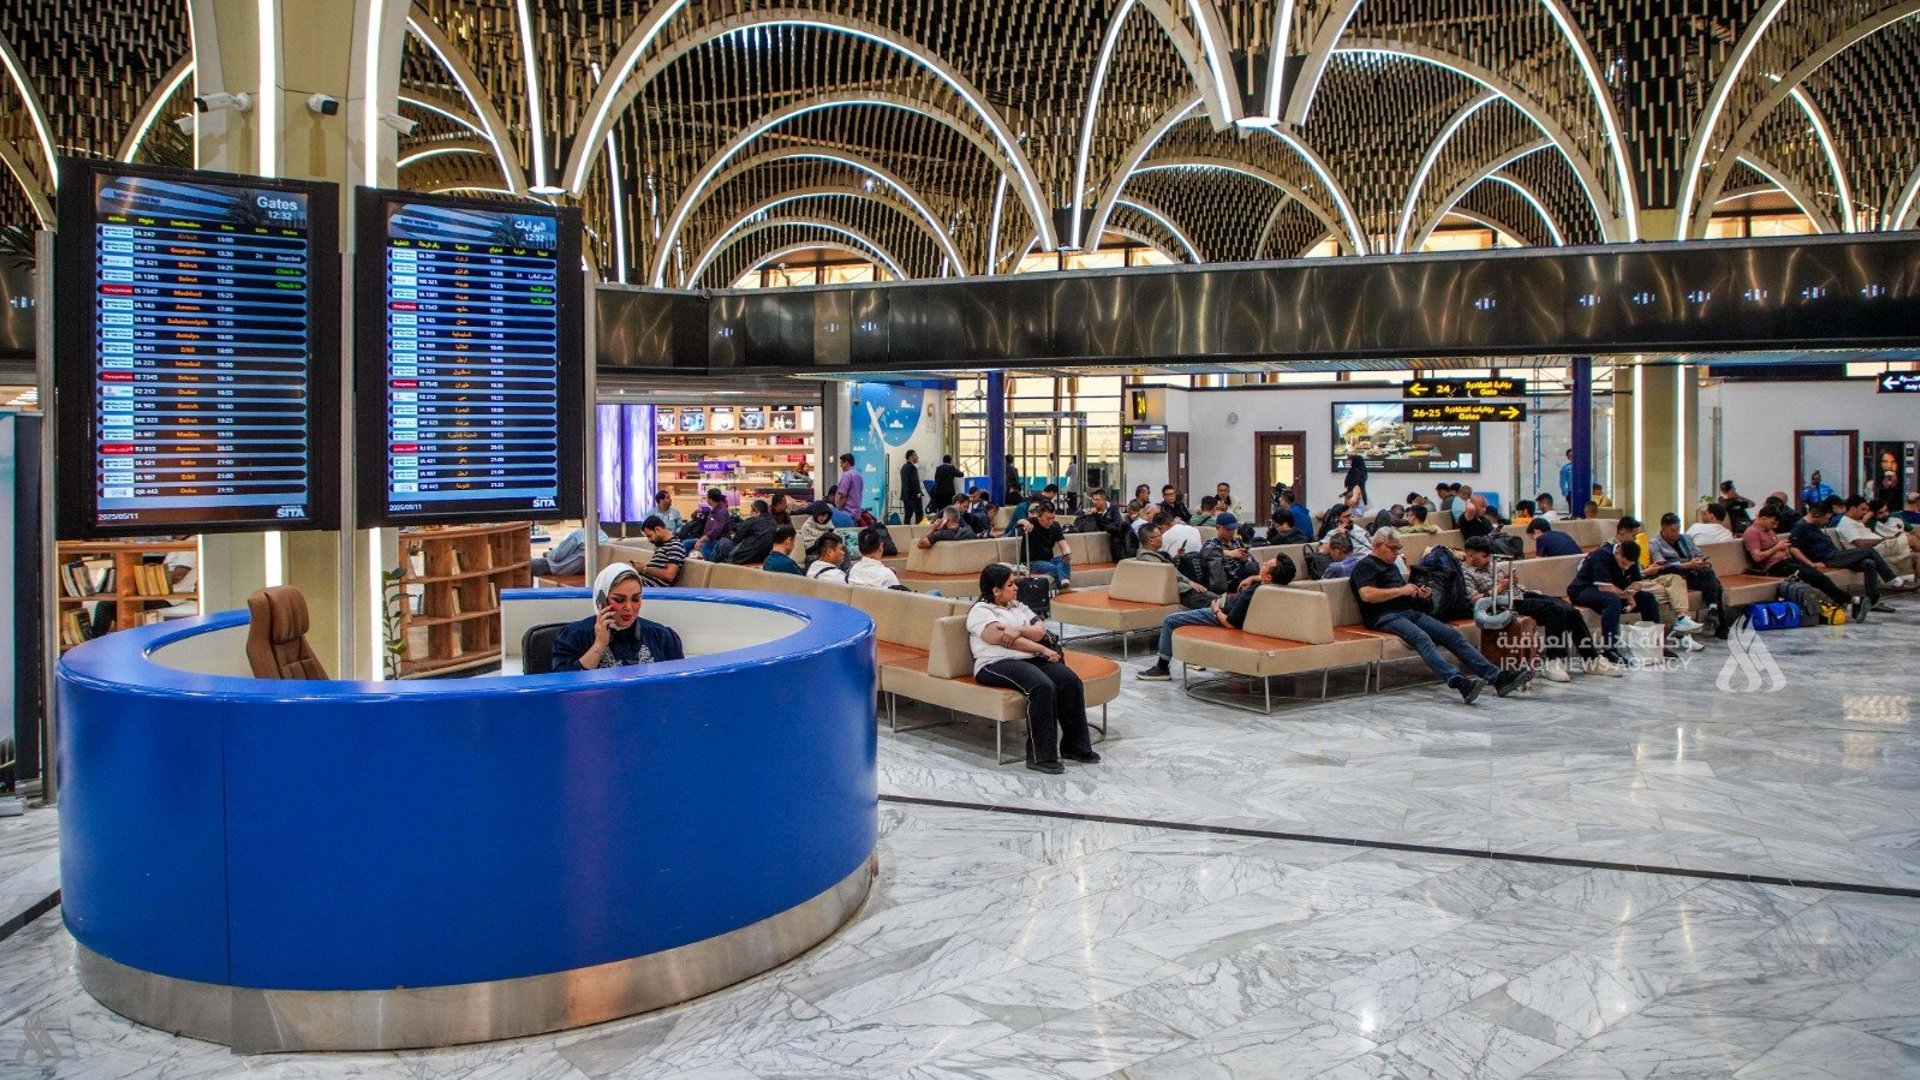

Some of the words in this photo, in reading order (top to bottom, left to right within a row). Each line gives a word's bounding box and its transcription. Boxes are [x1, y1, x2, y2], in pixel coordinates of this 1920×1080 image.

[256, 196, 298, 211] Gates
[267, 210, 292, 220] 12:32
[514, 220, 546, 232] البوابات
[1465, 381, 1493, 389] المغادرة
[1494, 381, 1513, 389] بوابة
[1436, 385, 1451, 394] 24
[1480, 388, 1498, 396] Gate
[1412, 409, 1441, 418] 26-25
[1444, 406, 1472, 414] المغادرة
[1472, 406, 1495, 414] بوابات
[533, 499, 556, 507] SITA
[276, 507, 305, 518] SITA
